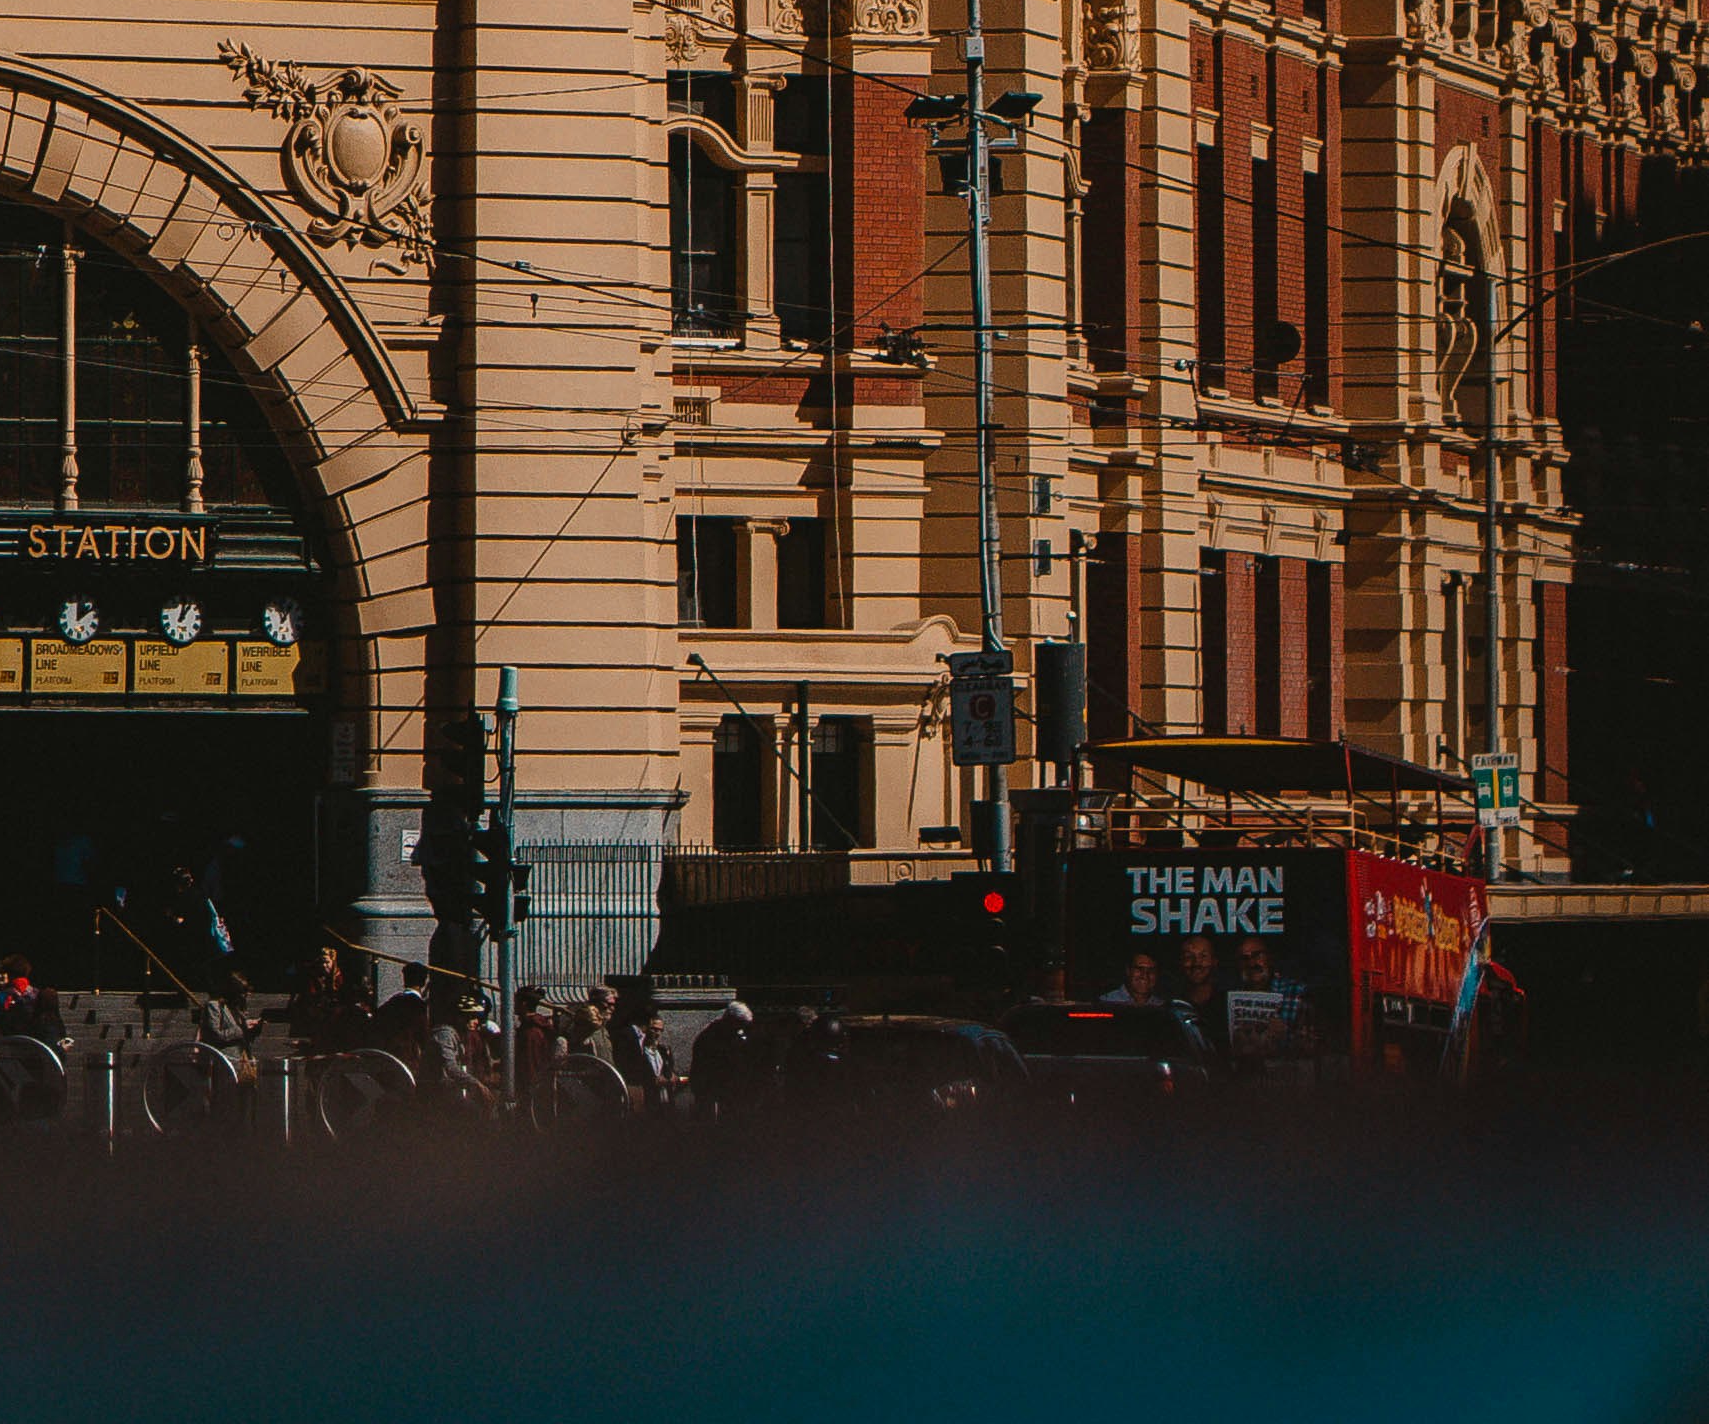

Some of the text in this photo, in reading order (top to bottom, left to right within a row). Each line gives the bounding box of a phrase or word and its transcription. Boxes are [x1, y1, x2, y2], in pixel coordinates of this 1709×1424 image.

[27, 524, 206, 561] STATION
[35, 643, 120, 656] BROADMEADOWS
[139, 644, 180, 657] UPFIELD
[241, 646, 292, 658] WERRIBEE
[35, 659, 58, 671] LINE
[139, 659, 161, 672] LINE
[241, 661, 263, 673] LINE
[35, 676, 73, 684] PLATFORM
[139, 677, 176, 686] PLATFORM
[241, 678, 279, 687] PLATFORM
[1125, 866, 1284, 895] THE MAN
[1129, 897, 1285, 936] SHAKE
